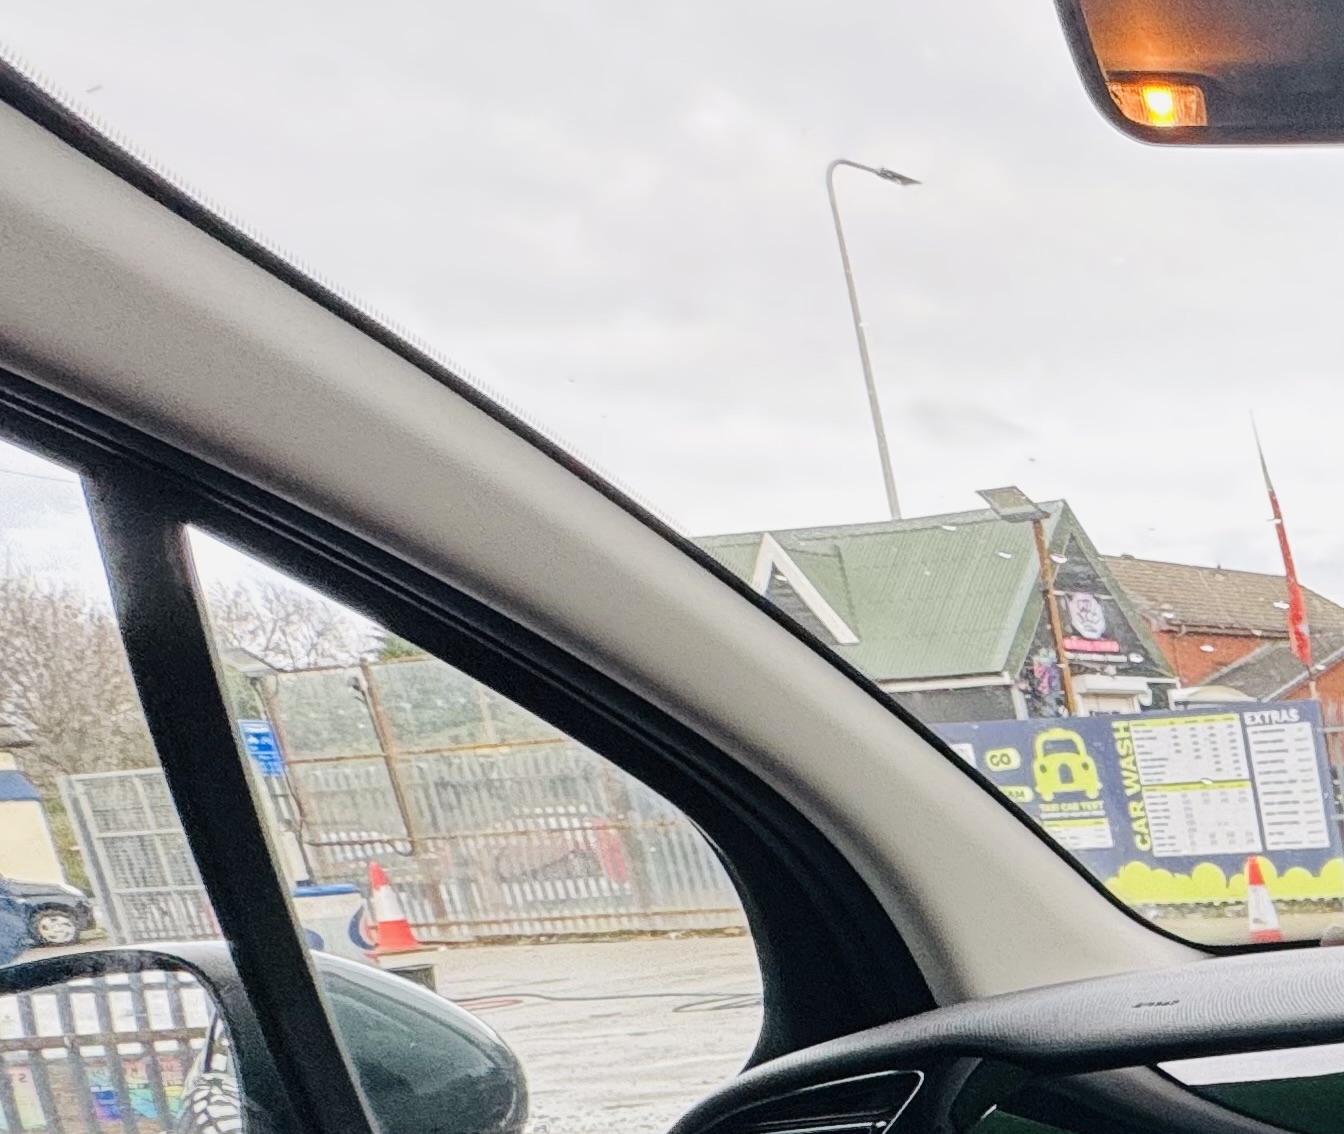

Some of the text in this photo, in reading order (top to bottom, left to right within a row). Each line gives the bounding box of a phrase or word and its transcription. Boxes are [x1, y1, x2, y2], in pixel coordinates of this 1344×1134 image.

[1243, 708, 1300, 725] EXTRAS
[1111, 721, 1152, 851] CAR WASH
